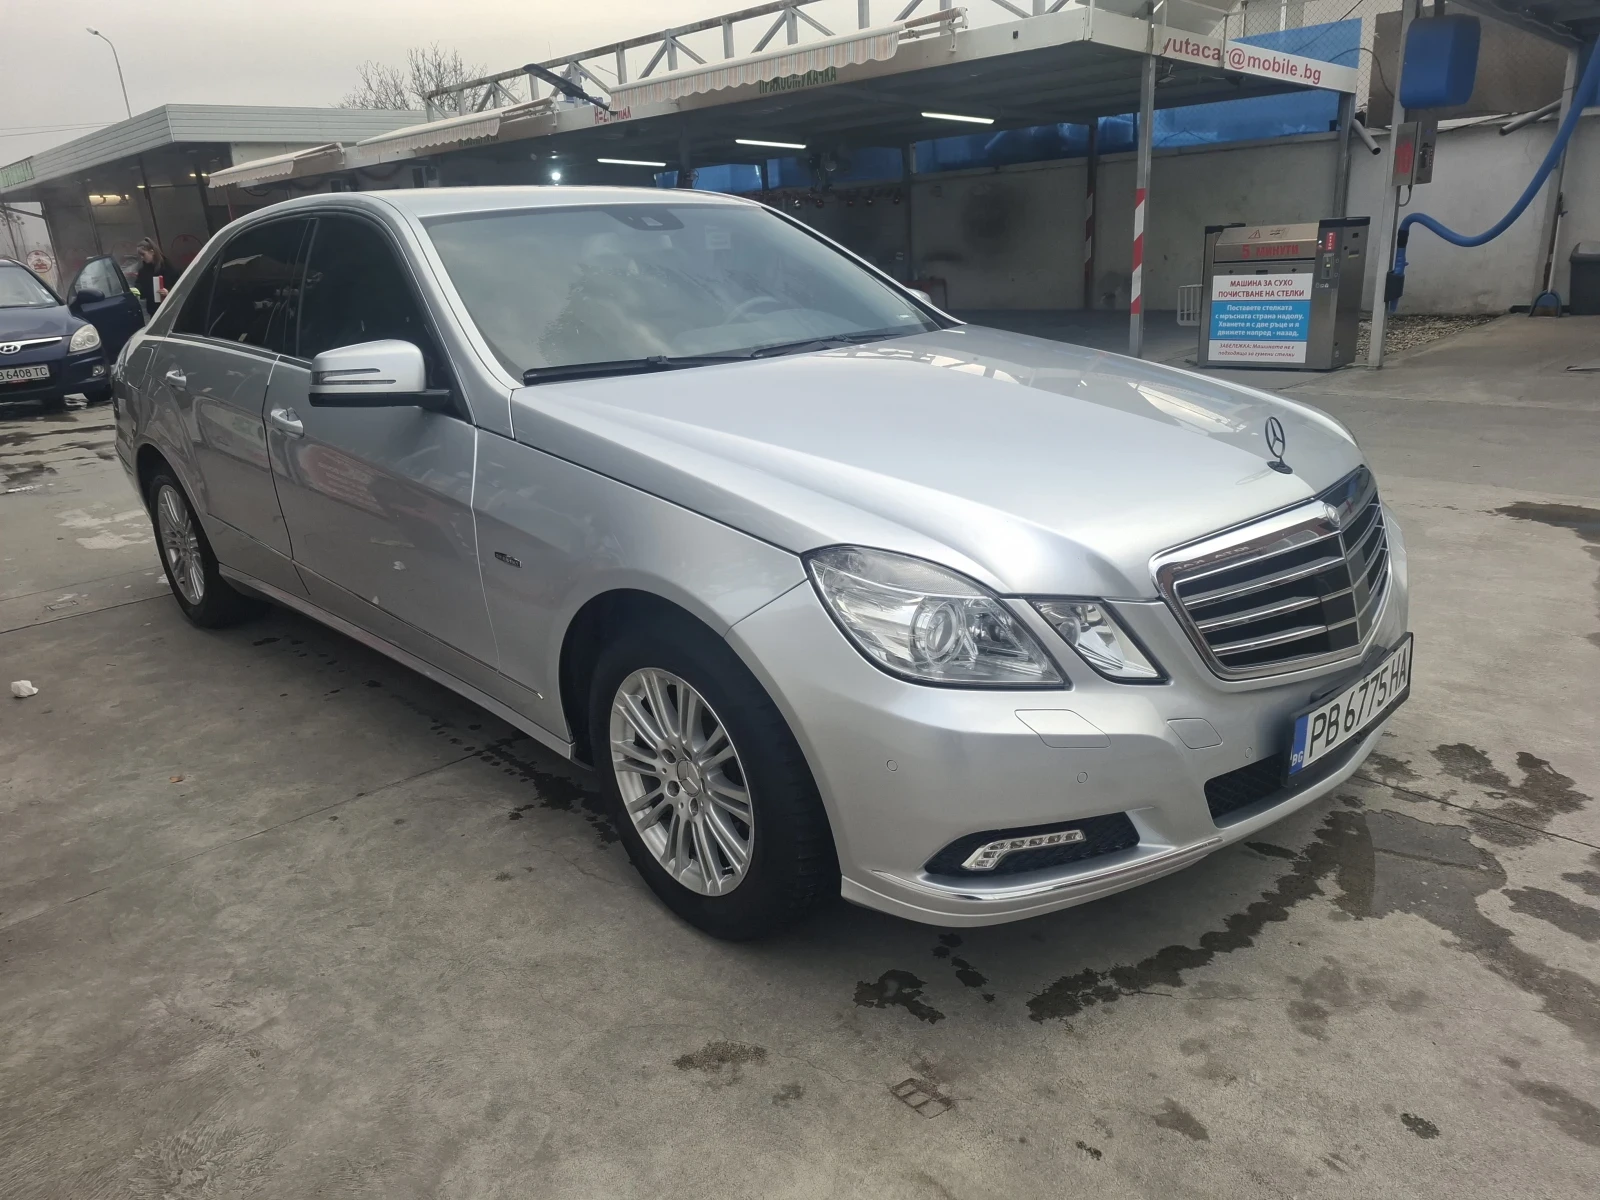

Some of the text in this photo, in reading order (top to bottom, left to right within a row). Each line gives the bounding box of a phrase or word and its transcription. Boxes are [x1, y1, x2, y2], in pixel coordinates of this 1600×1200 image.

[1242, 244, 1250, 259] 5
[1218, 290, 1264, 298] ПОЧИСТВАНЕ
[6, 369, 32, 380] 6408
[1291, 751, 1304, 767] BG
